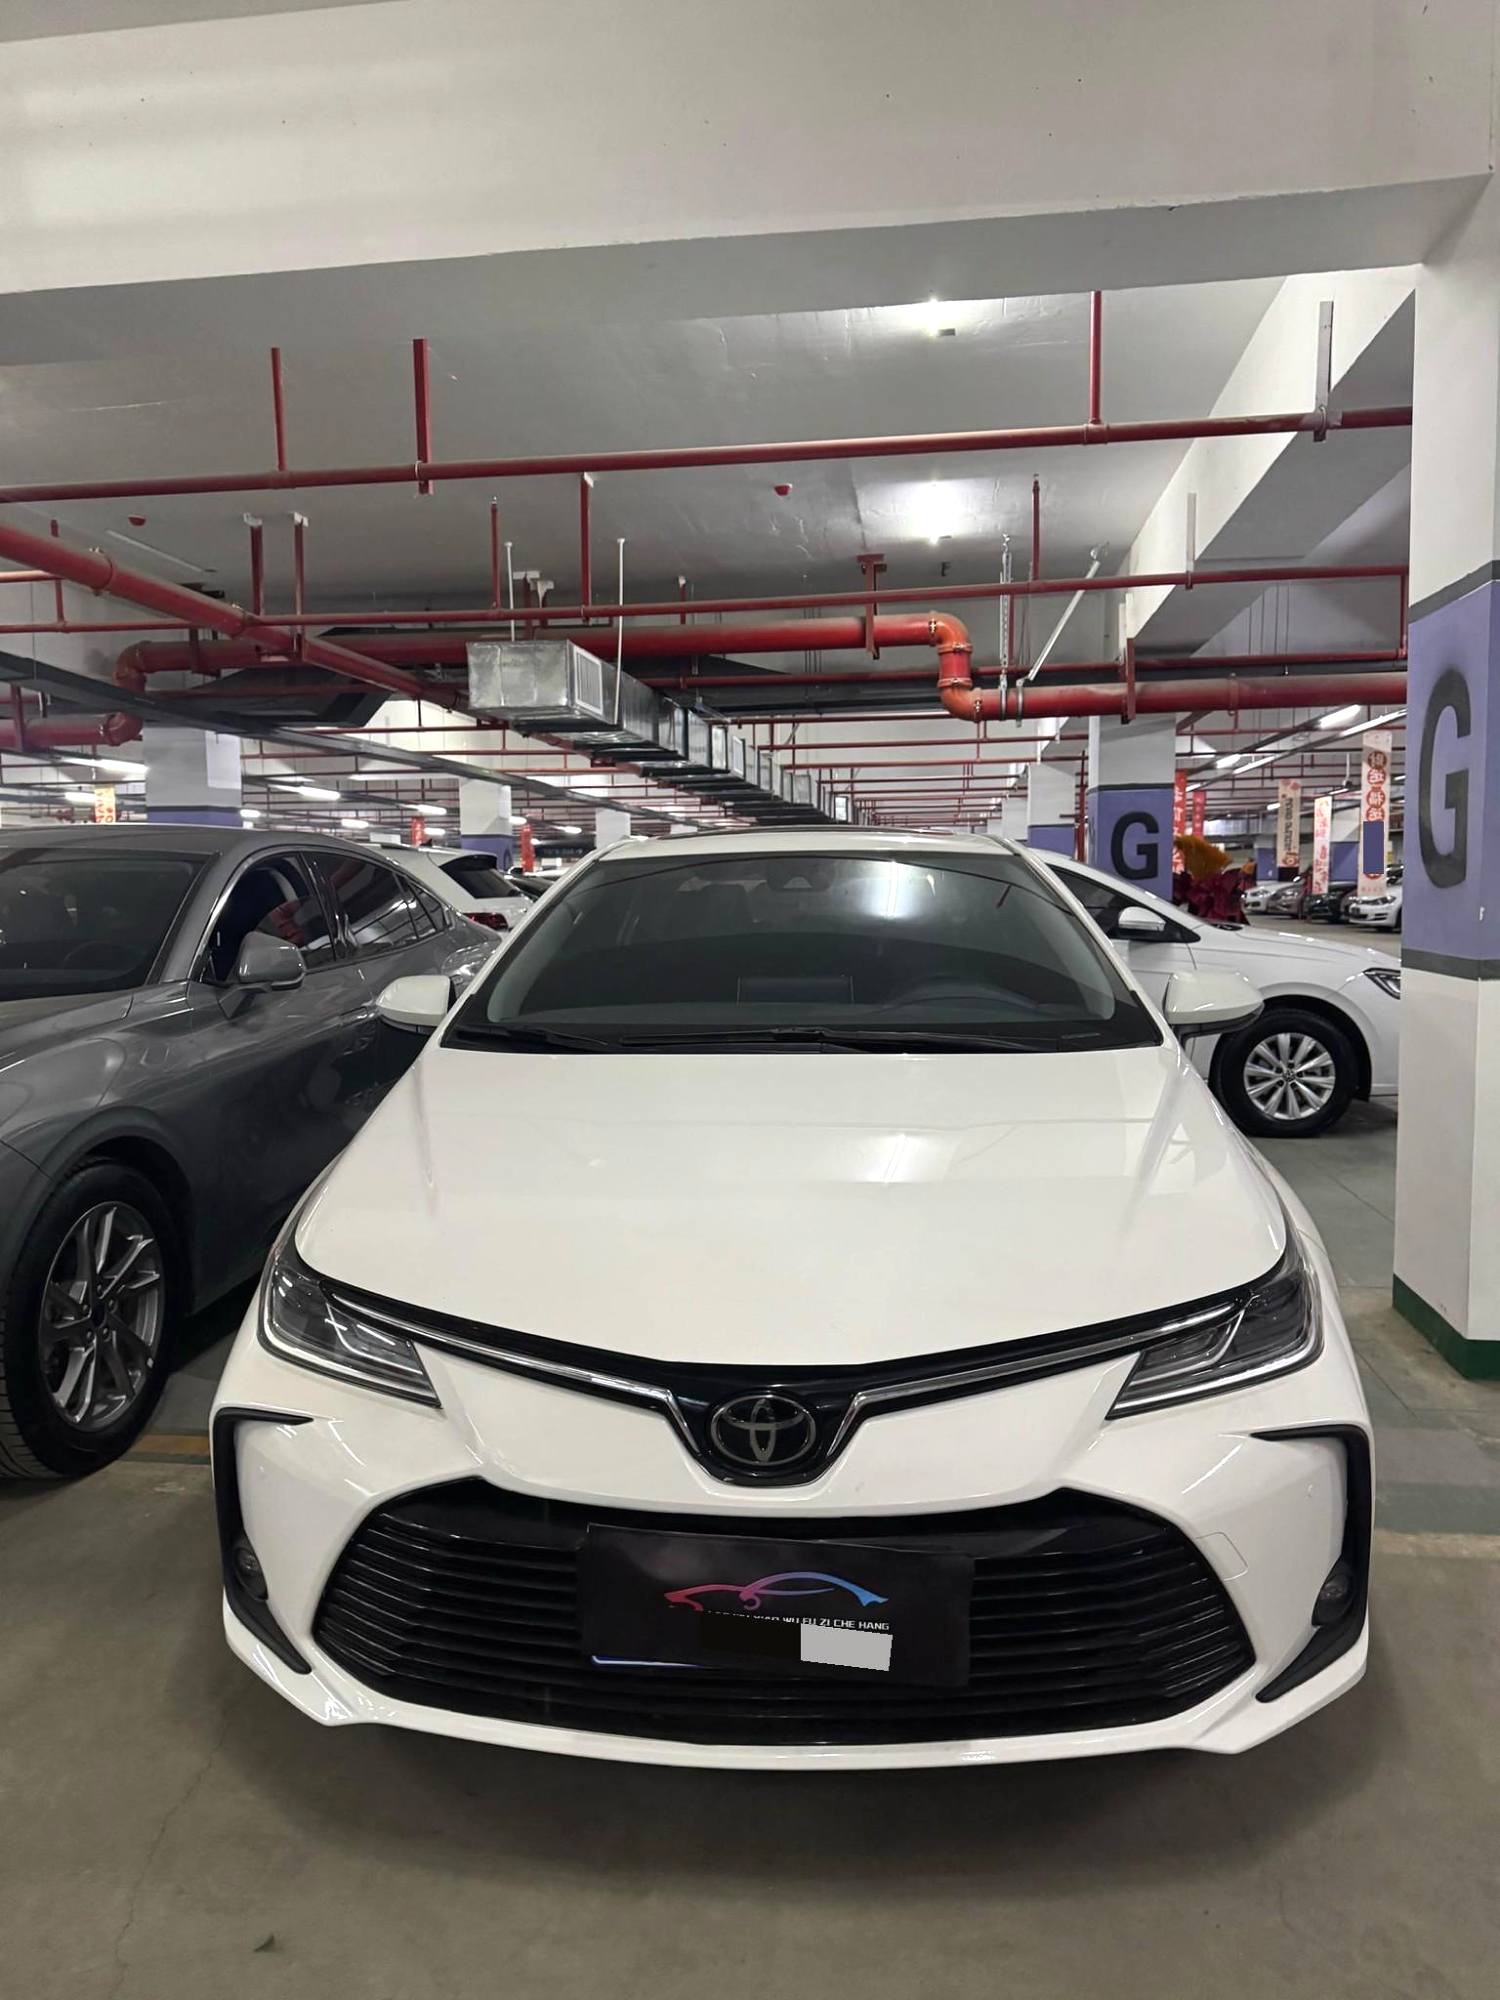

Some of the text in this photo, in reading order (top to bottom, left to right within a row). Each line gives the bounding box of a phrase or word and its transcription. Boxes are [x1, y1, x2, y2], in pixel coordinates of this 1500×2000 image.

[1418, 667, 1471, 888] G
[1110, 811, 1160, 880] G
[819, 1618, 831, 1627] ZI
[833, 1619, 856, 1629] CHE
[858, 1621, 890, 1631] HANG
